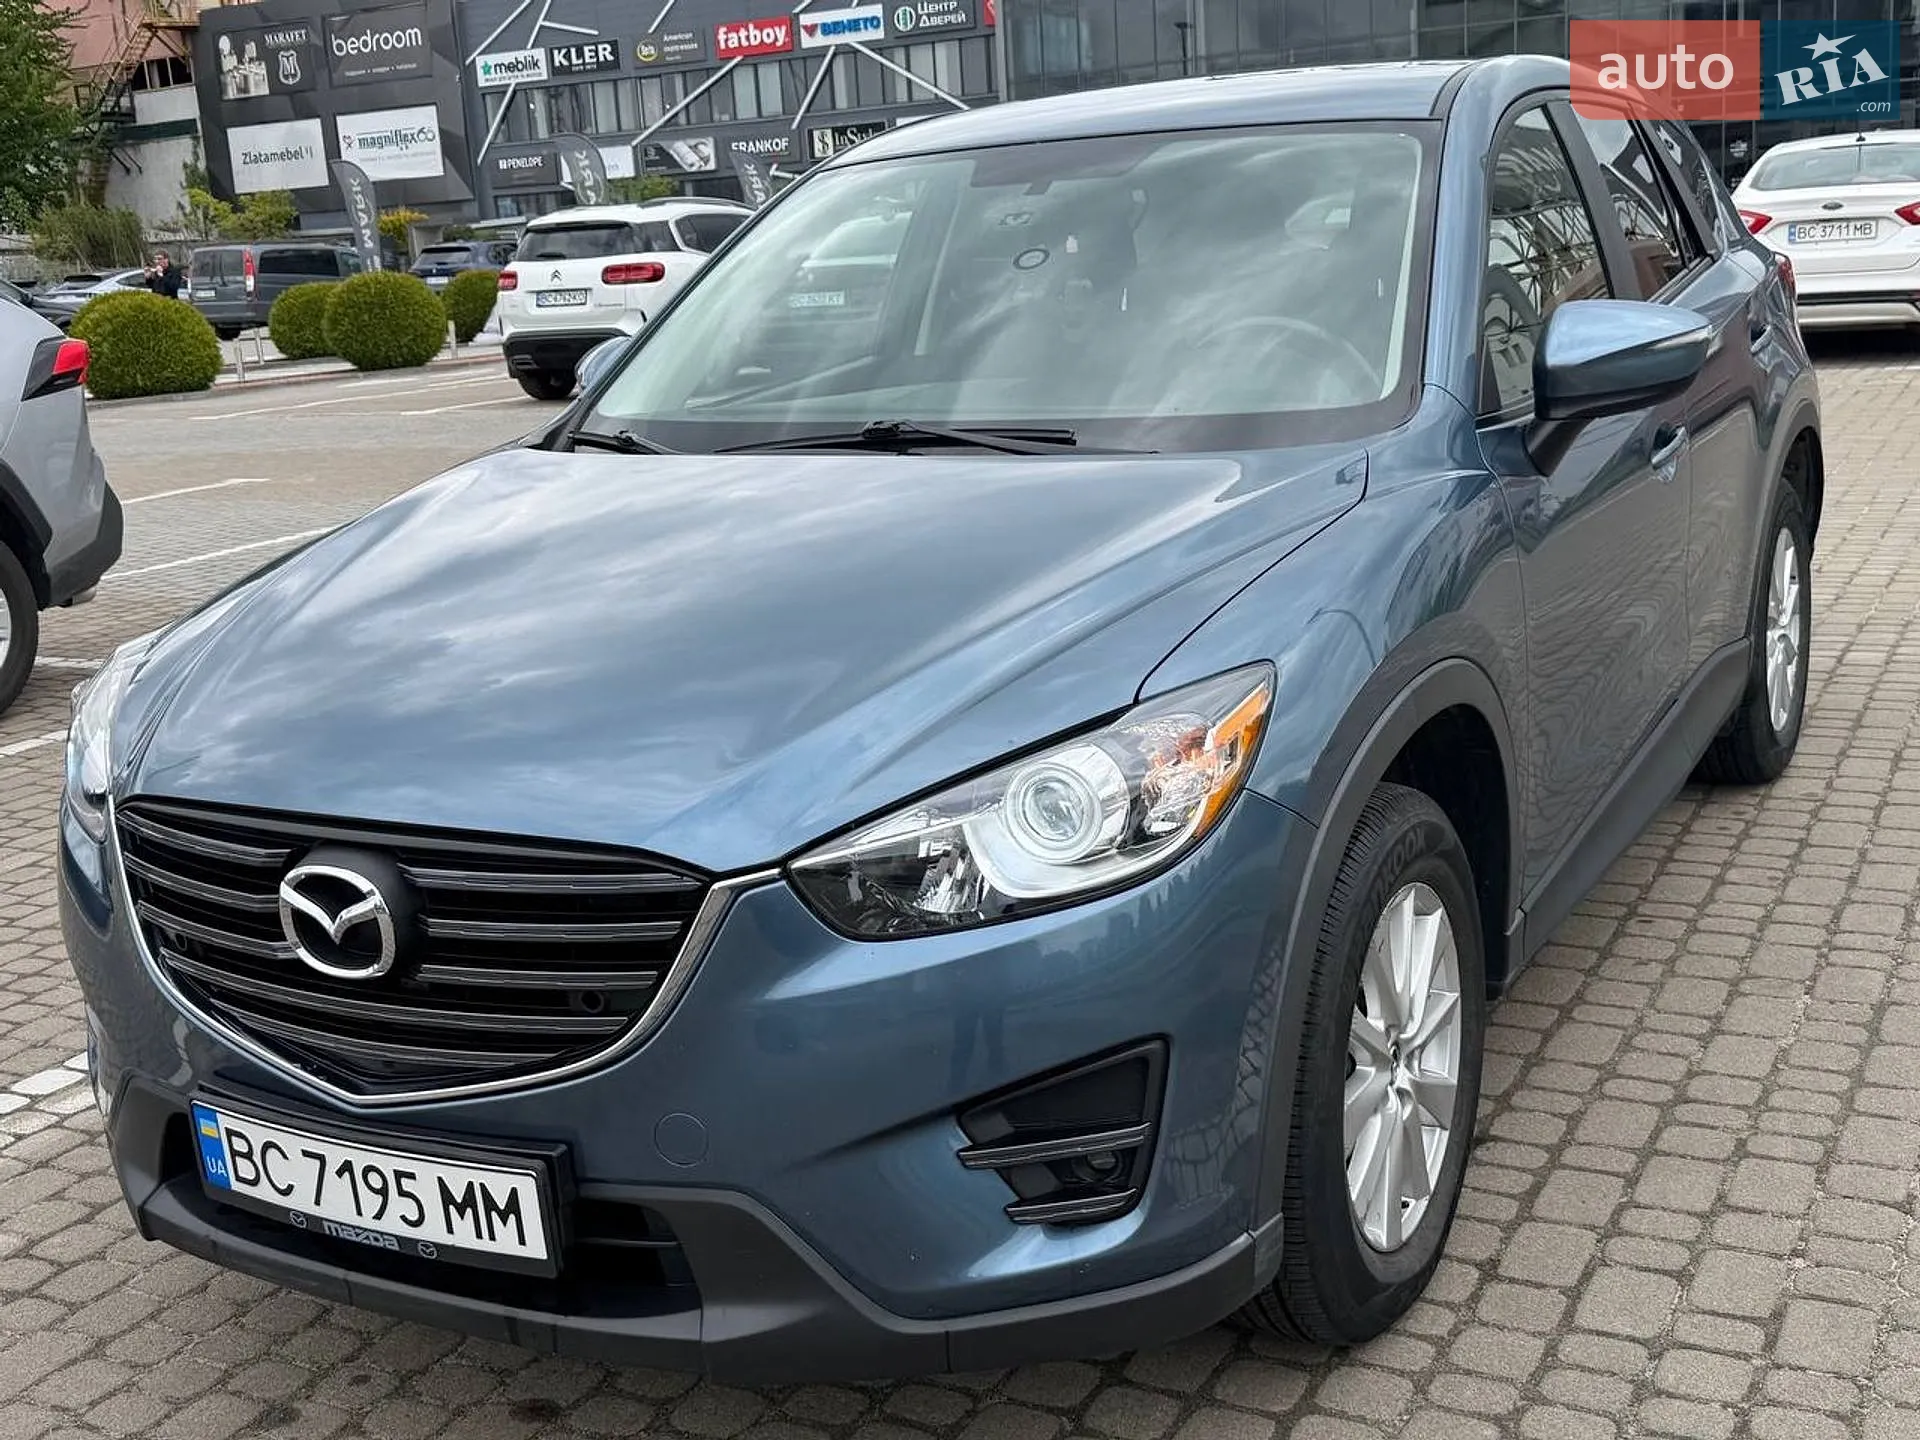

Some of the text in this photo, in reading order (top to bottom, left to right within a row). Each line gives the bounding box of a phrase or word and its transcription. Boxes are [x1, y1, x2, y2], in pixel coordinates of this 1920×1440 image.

[331, 26, 423, 57] bedroom
[717, 23, 787, 50] fatboy
[493, 55, 540, 75] meblik
[552, 43, 615, 67] KLER
[241, 145, 305, 165] Zlatamebel
[731, 137, 789, 154] FRANKOF
[1797, 226, 1817, 239] BC
[1819, 224, 1850, 239] 3711
[1853, 223, 1873, 236] MB
[207, 1156, 228, 1176] UA
[224, 1126, 526, 1246] BC 7195 MM
[321, 1220, 400, 1251] mazda
